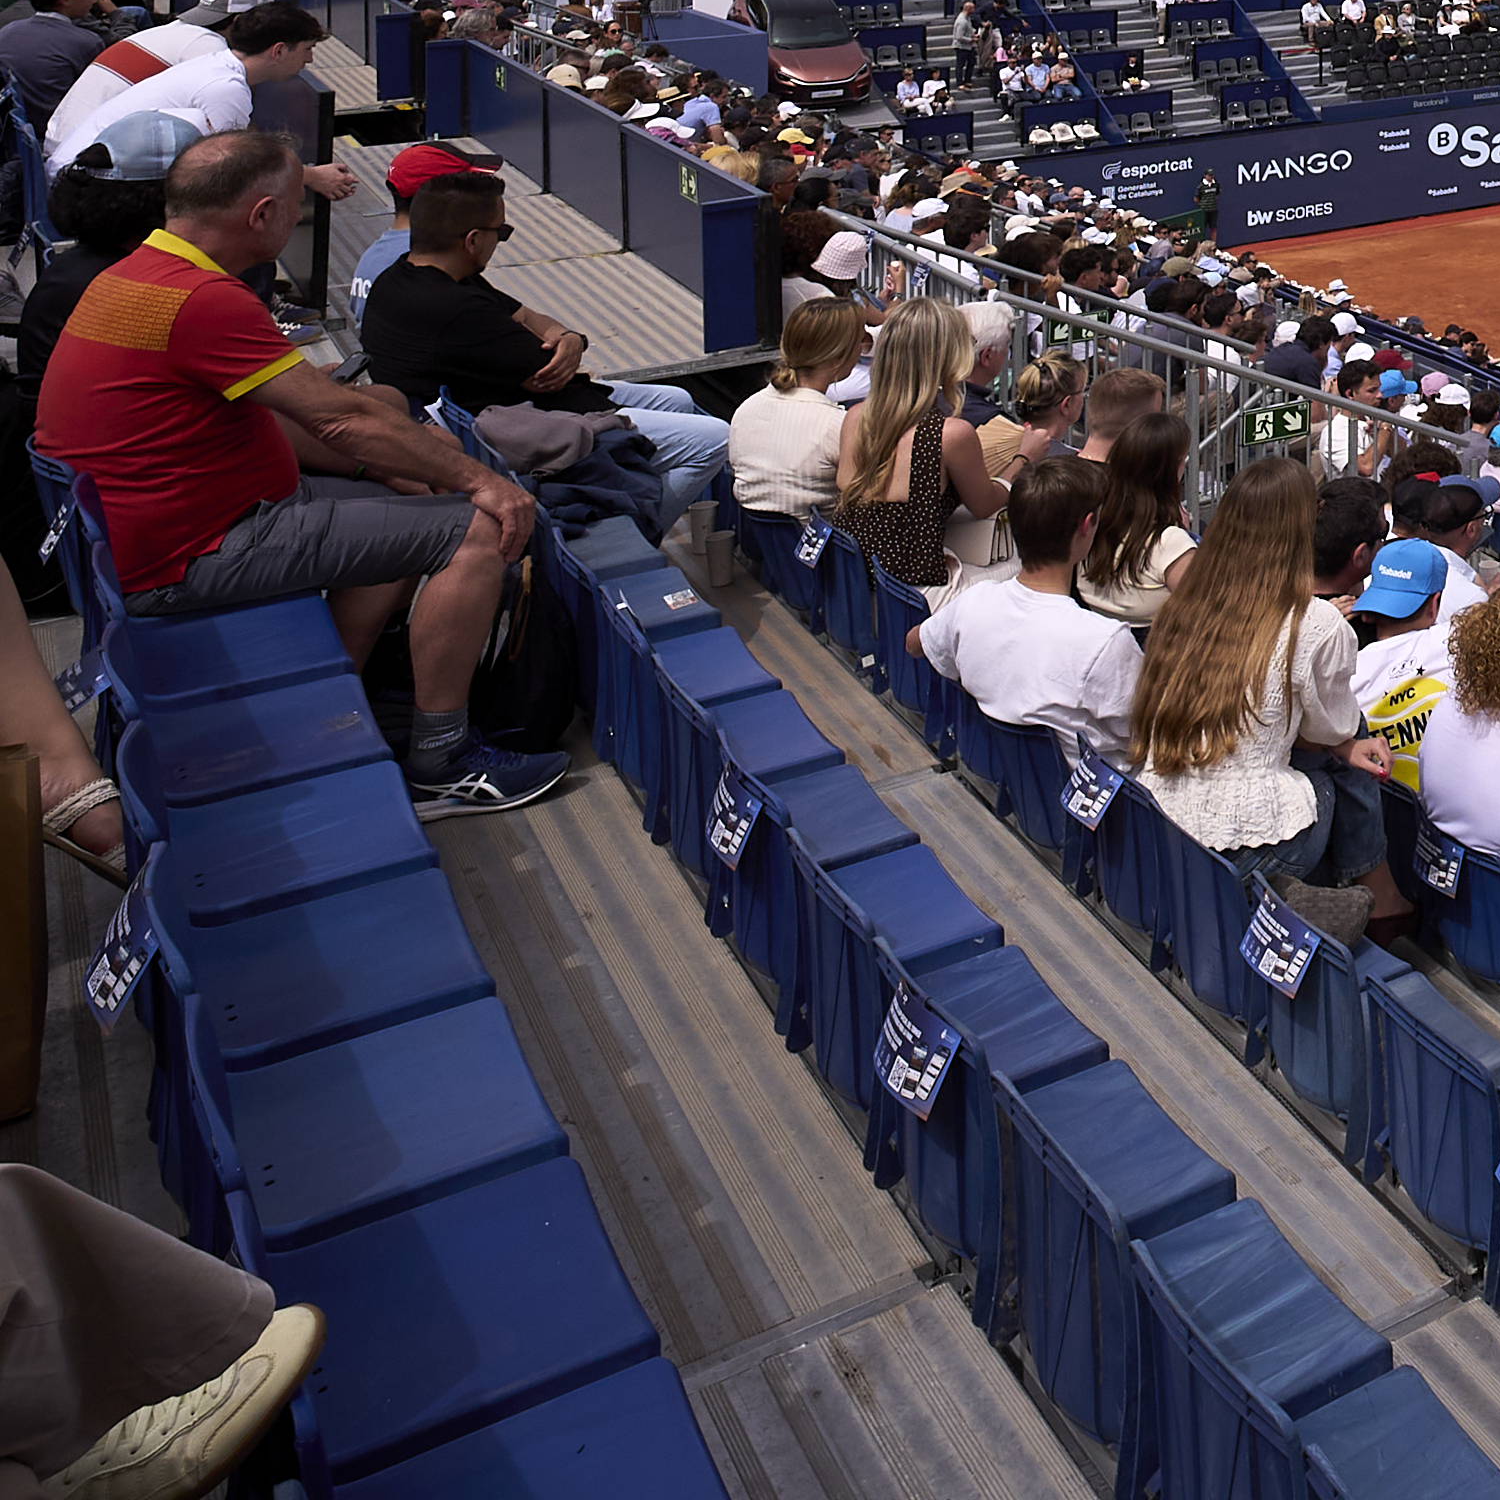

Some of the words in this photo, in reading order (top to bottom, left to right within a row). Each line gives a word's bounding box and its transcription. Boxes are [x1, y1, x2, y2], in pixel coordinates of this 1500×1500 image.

[1413, 97, 1444, 108] Barcelona
[1121, 156, 1194, 180] esportcat
[1237, 149, 1353, 185] MANGO
[1117, 182, 1158, 194] Generalitat
[1117, 193, 1127, 201] de
[1128, 187, 1164, 202] Catalunya
[1275, 202, 1334, 223] SCORES
[1382, 566, 1413, 580] Sabadell
[1389, 687, 1416, 707] NYC
